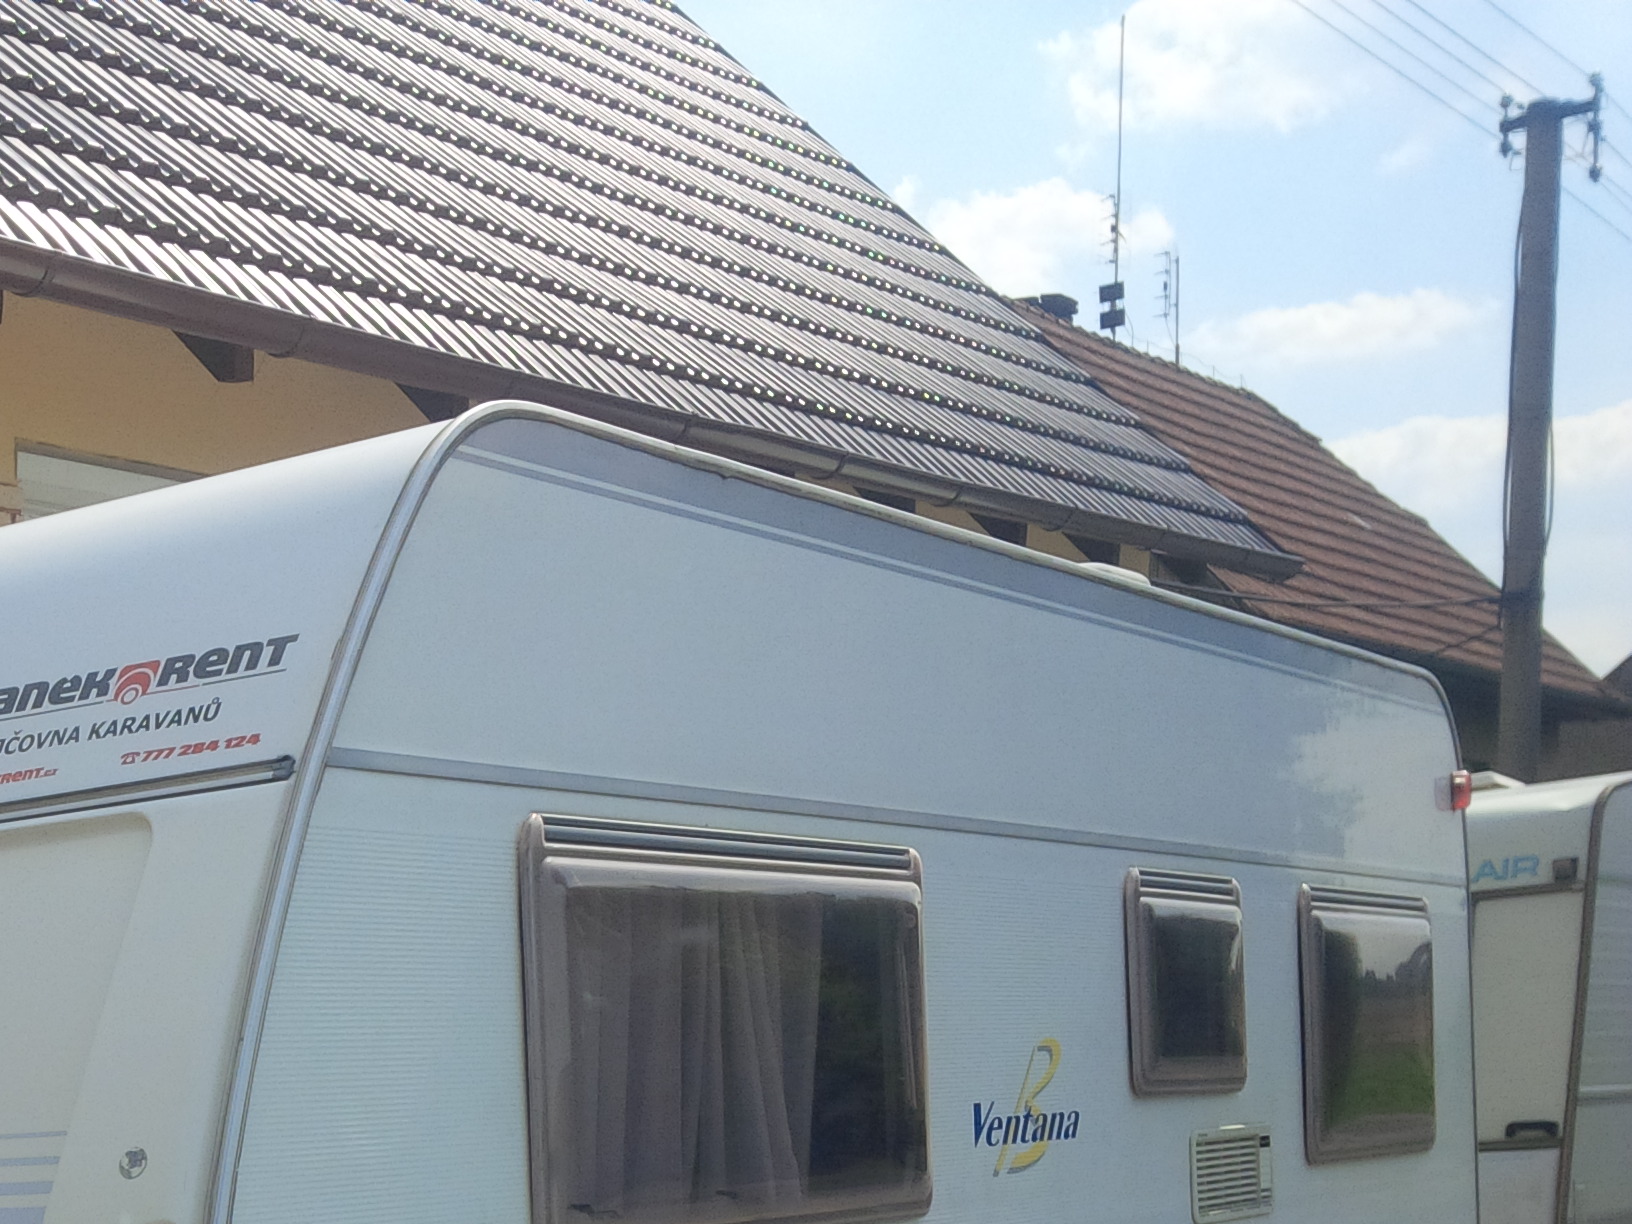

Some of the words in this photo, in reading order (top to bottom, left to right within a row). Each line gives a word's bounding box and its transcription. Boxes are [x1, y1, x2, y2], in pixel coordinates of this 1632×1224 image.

[87, 697, 222, 741] KARAVANŮ
[142, 748, 176, 762] 777
[225, 733, 261, 749] 124
[973, 1101, 1080, 1148] Ventana
